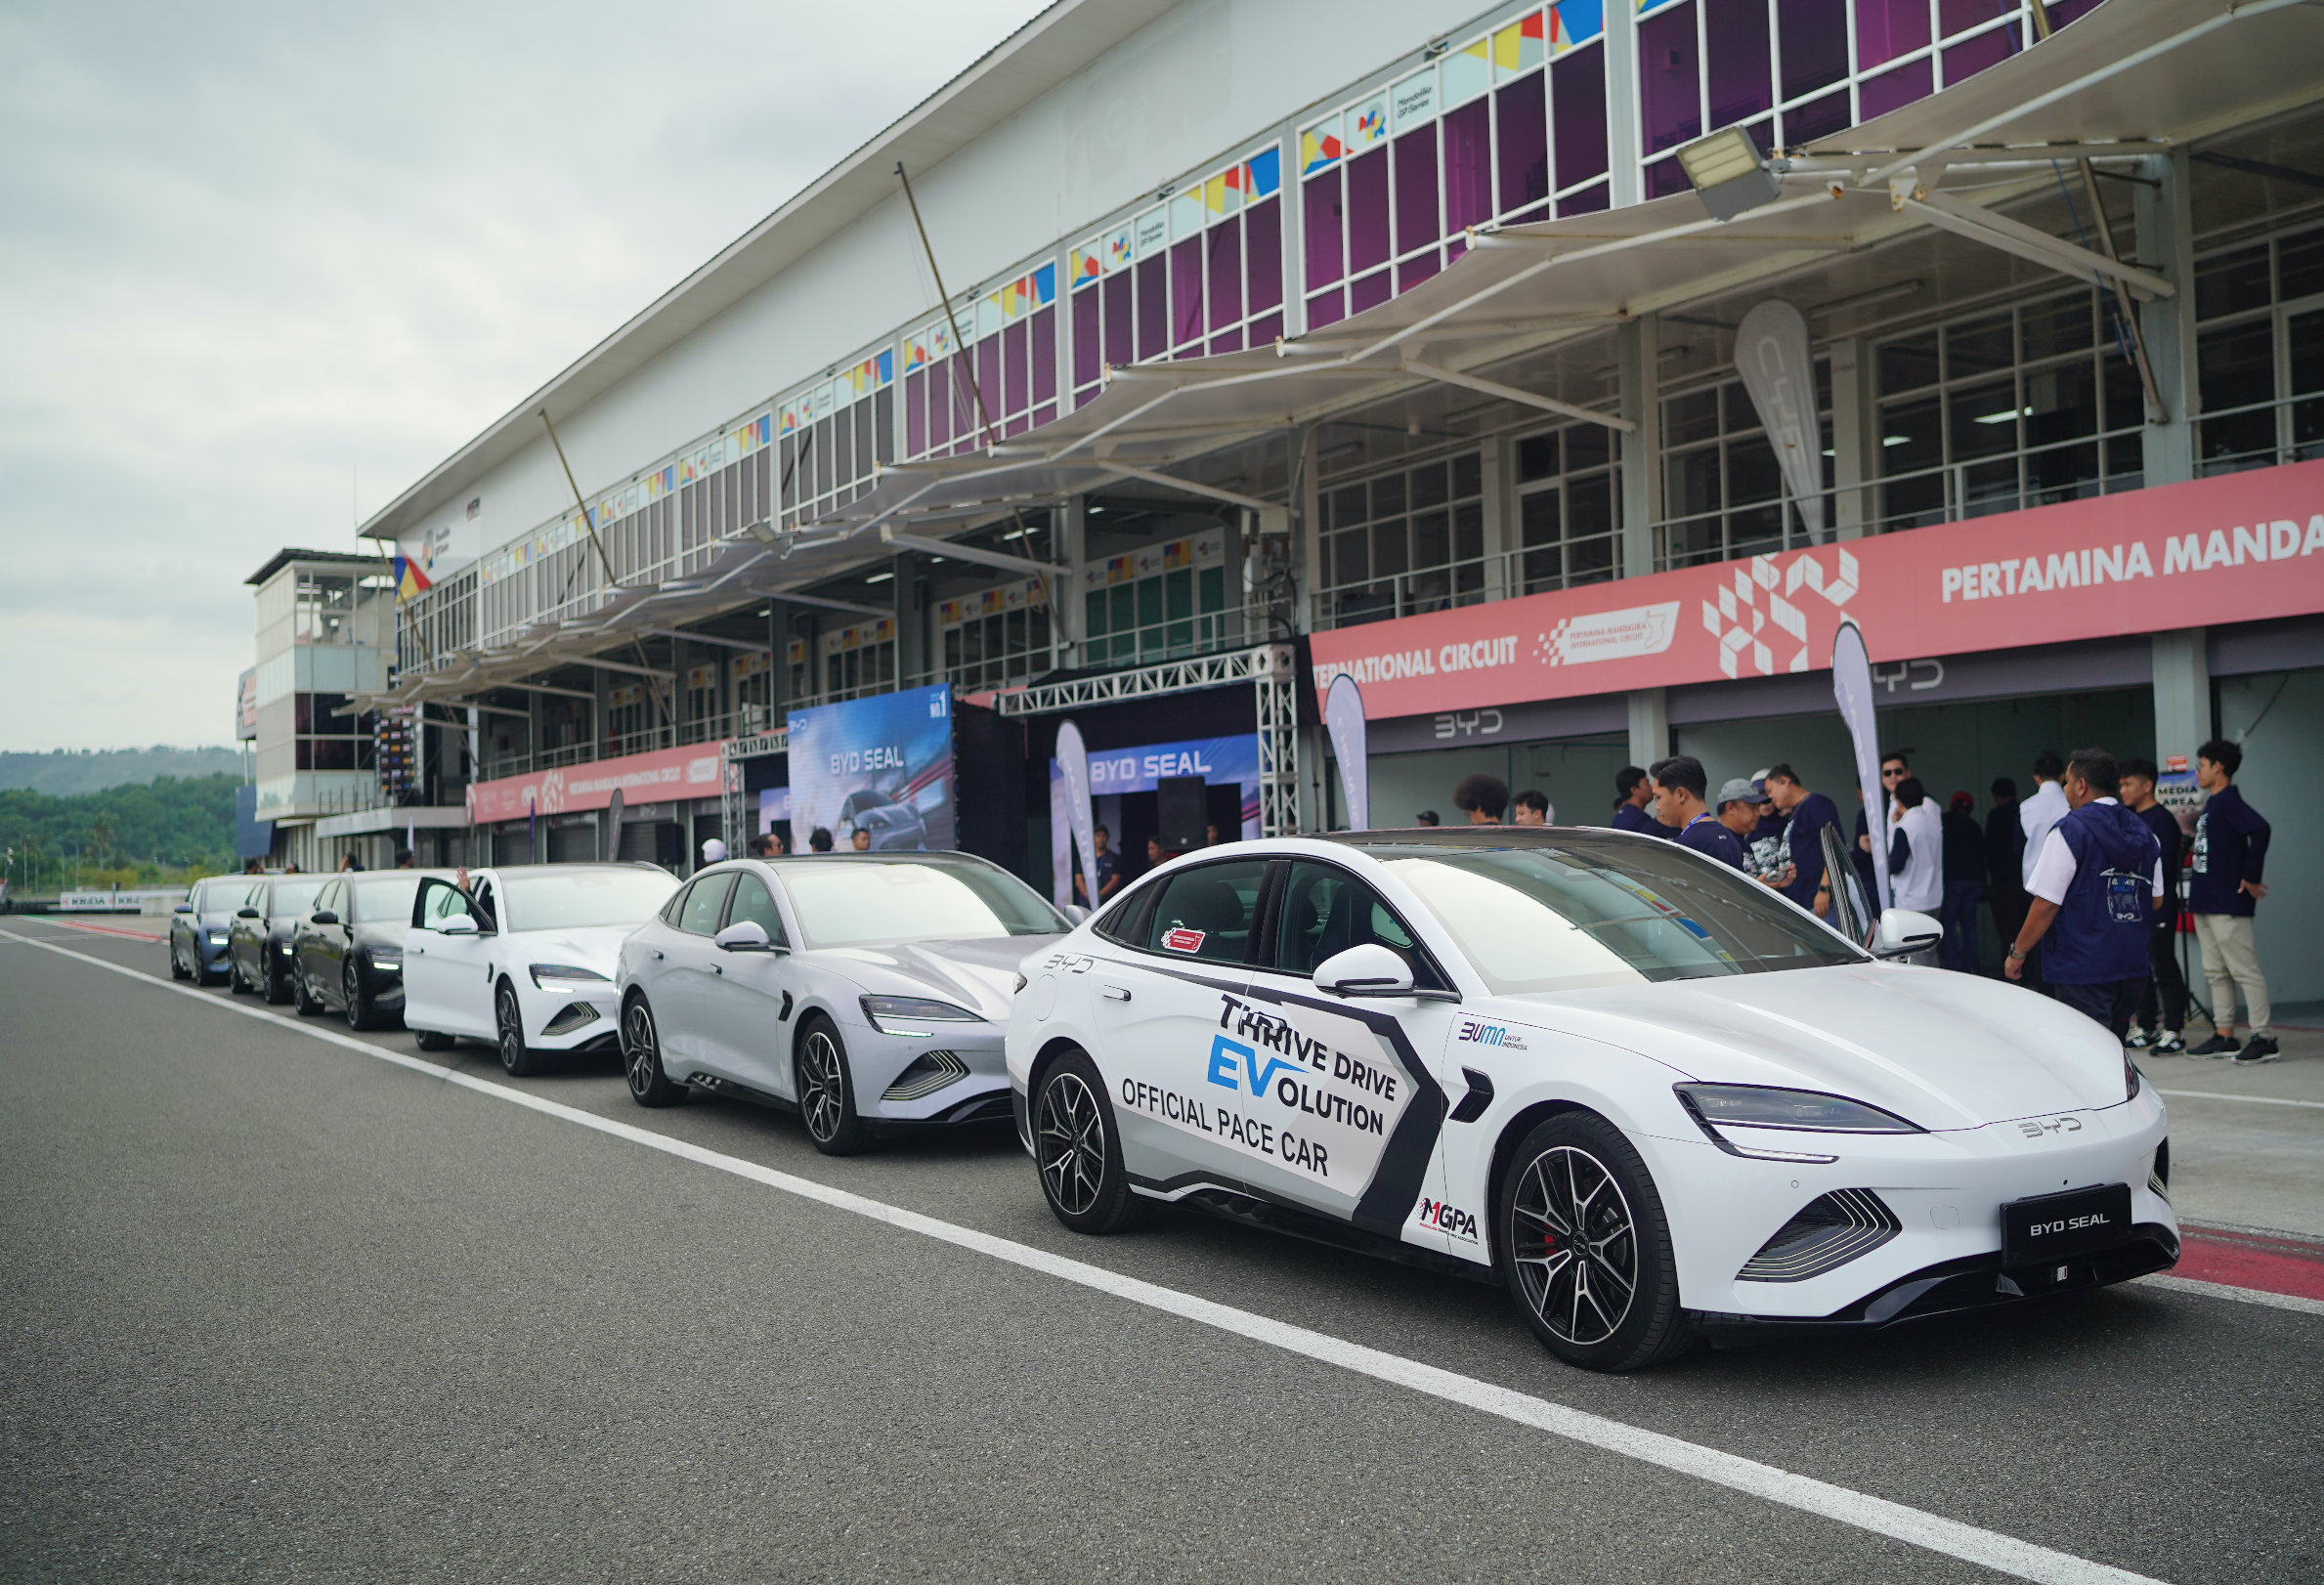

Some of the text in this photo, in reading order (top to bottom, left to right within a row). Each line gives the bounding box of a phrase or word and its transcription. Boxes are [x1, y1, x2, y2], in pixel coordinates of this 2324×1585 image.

[1942, 514, 2324, 603] PERTAMINA MANDA
[1570, 622, 1647, 640] PERTAMINA MANDALIKA
[1570, 632, 1644, 650] INTERNATIONAL CIRCUIT
[1313, 635, 1518, 690] TERNATIONAL CIRCUIT
[1872, 659, 1944, 693] YD
[1435, 708, 1503, 740] BYD
[831, 746, 904, 775] BYD SEAL
[1091, 750, 1212, 782] BYD SEAL
[2158, 785, 2198, 796] MEDIA
[2162, 796, 2196, 806] AREA
[1043, 954, 1094, 974] BYD
[1220, 994, 1397, 1101] THRIVE DRIVE
[1123, 1078, 1328, 1178] OFFICIAL PACE CAR
[2018, 1117, 2082, 1138] BYD
[1421, 1197, 1478, 1239] MGPA
[2030, 1213, 2111, 1237] BYD SEAL
